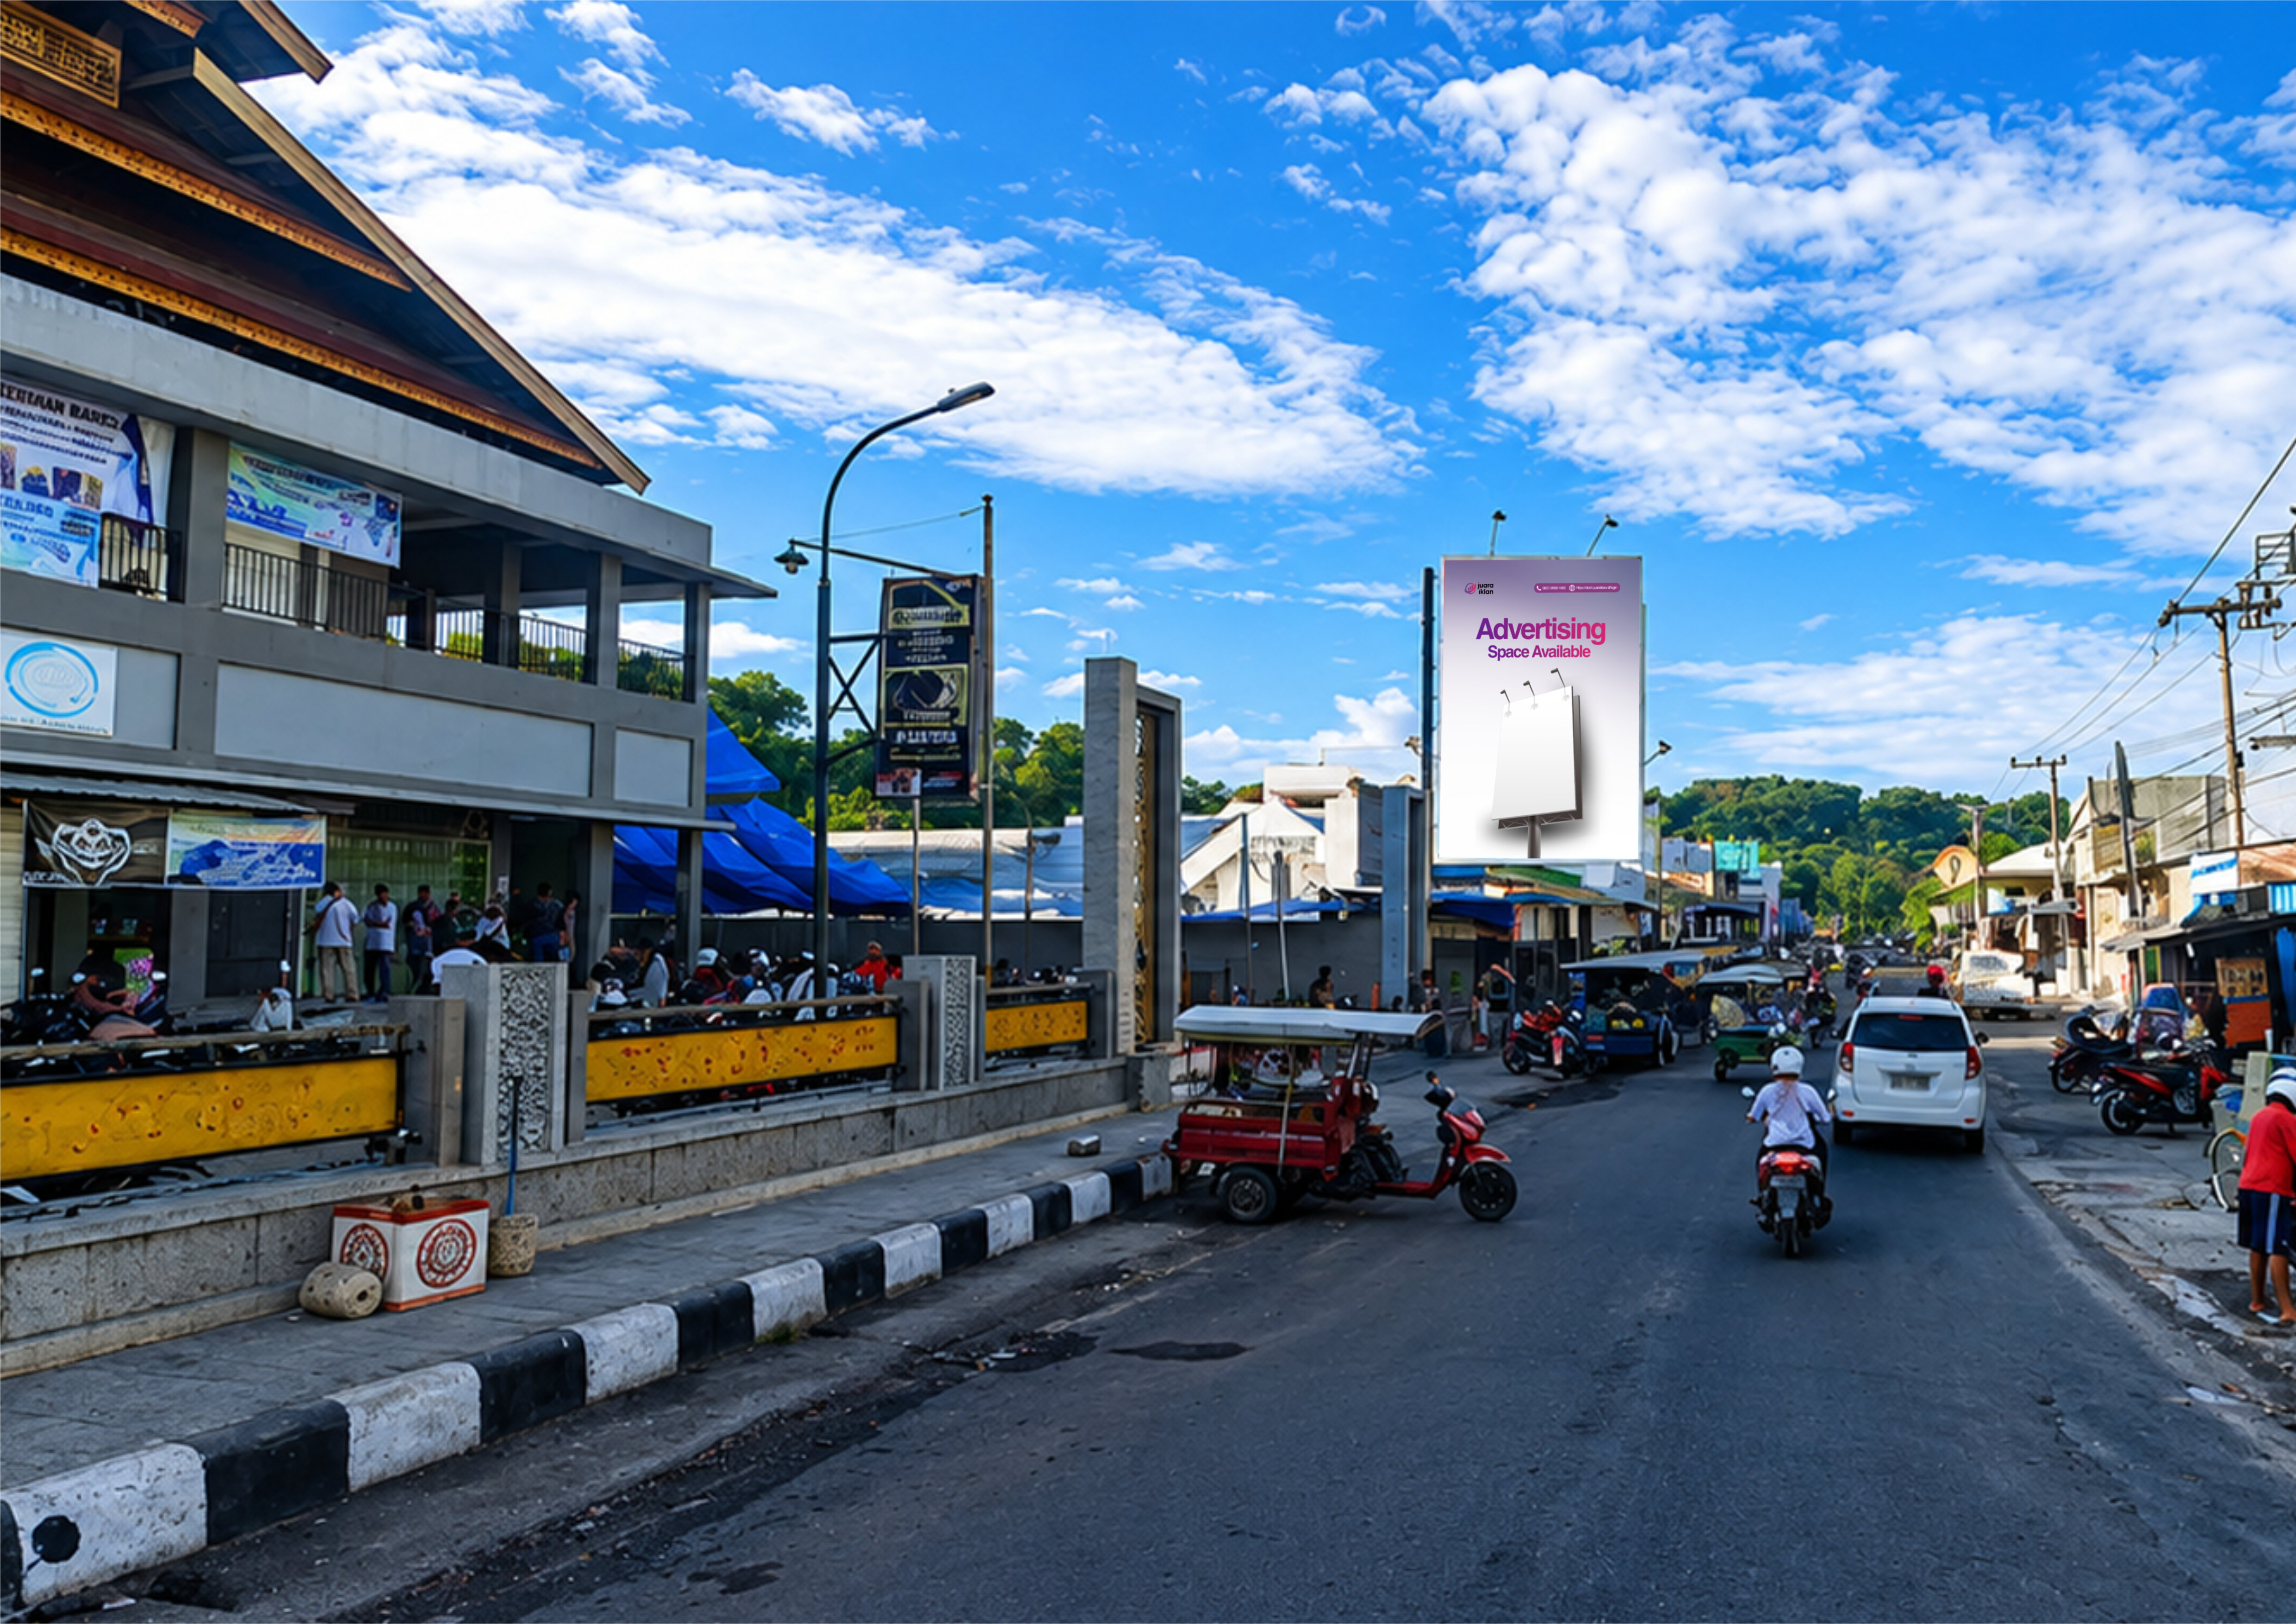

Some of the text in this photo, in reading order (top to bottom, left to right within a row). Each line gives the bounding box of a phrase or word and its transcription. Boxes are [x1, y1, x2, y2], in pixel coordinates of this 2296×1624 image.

[1476, 617, 1606, 645] Advertising
[1488, 644, 1591, 661] Space Available
